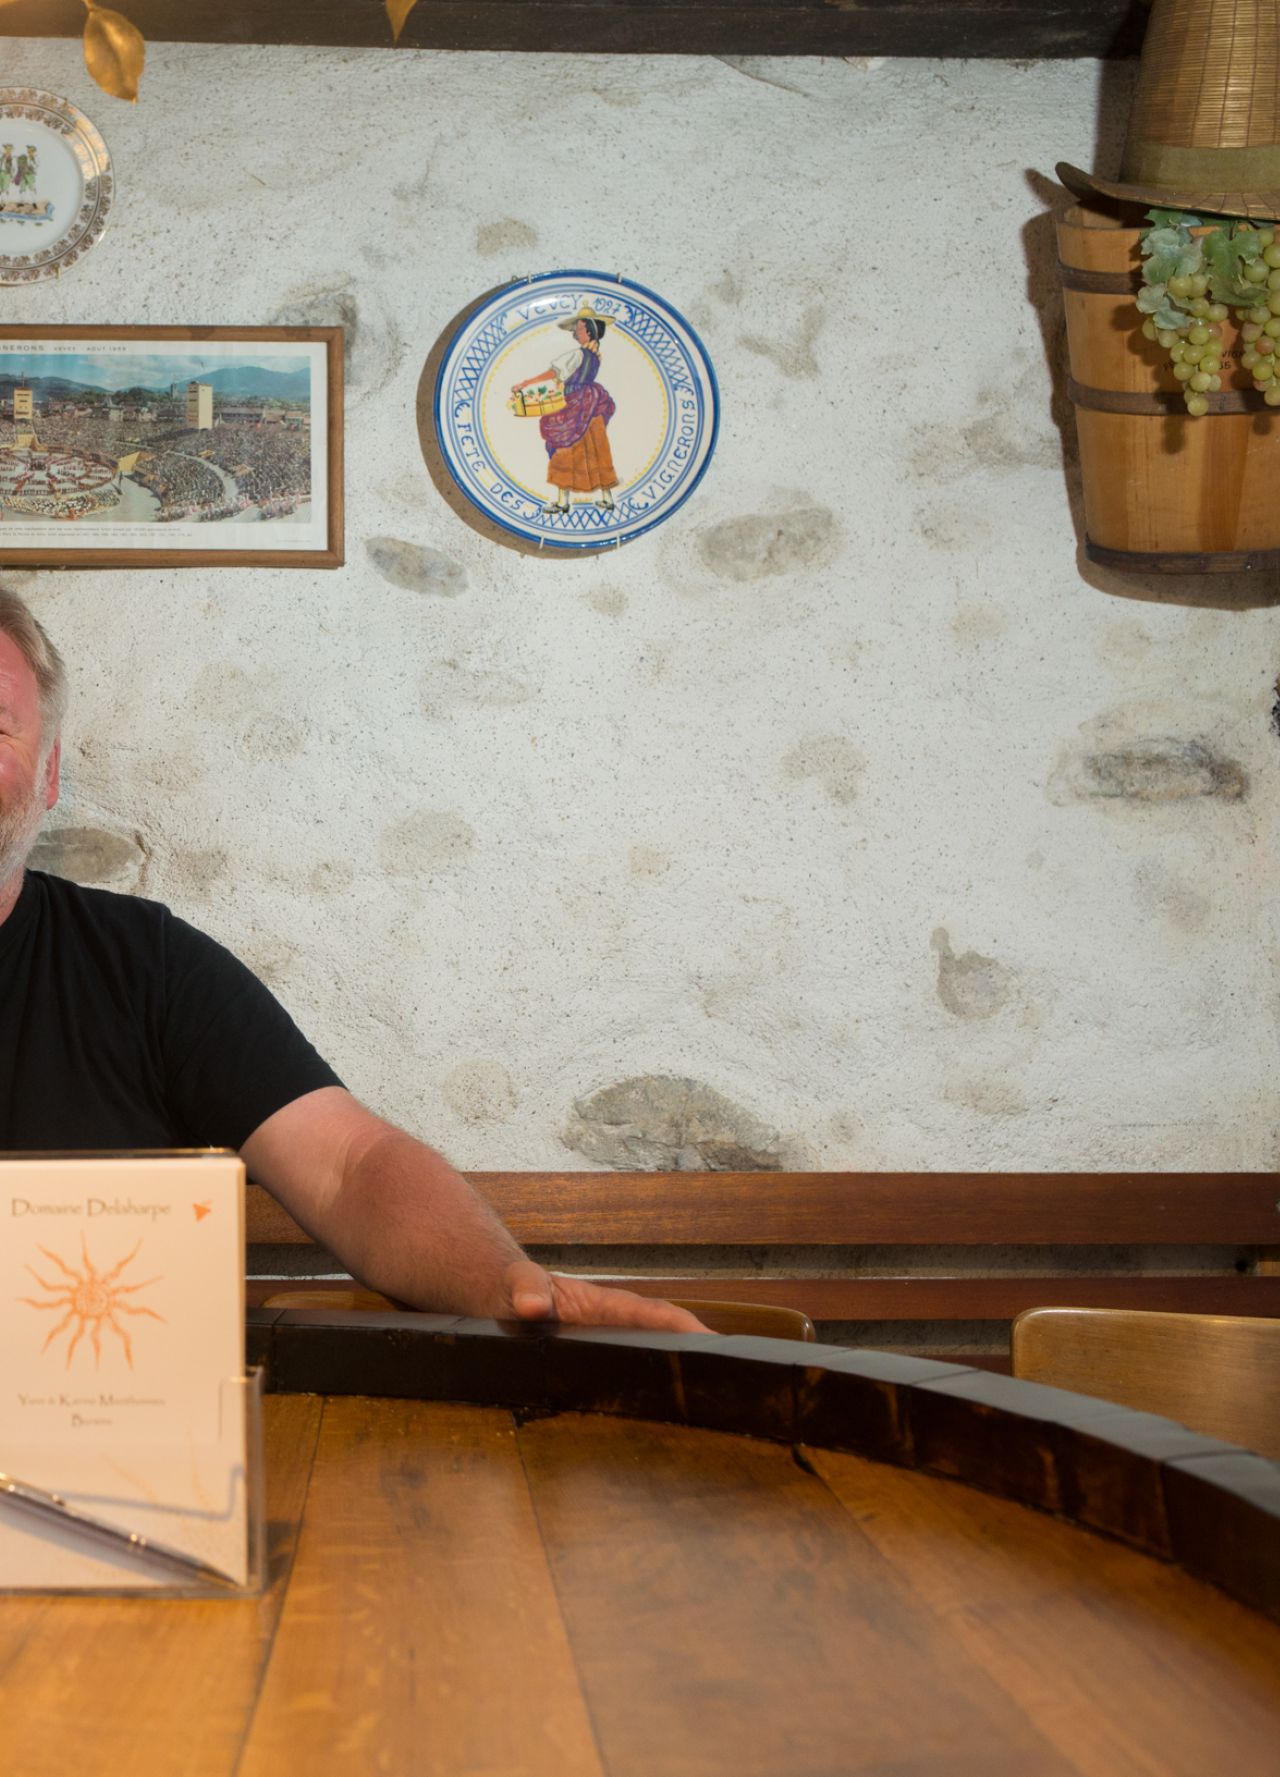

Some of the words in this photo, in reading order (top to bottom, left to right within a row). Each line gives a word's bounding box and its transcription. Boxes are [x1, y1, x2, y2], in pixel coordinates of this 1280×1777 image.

[457, 423, 487, 473] FETE
[490, 482, 524, 511] DES
[641, 399, 696, 499] VIGNERONS
[11, 1197, 82, 1218] Domaine
[87, 1196, 172, 1223] Delaharpe
